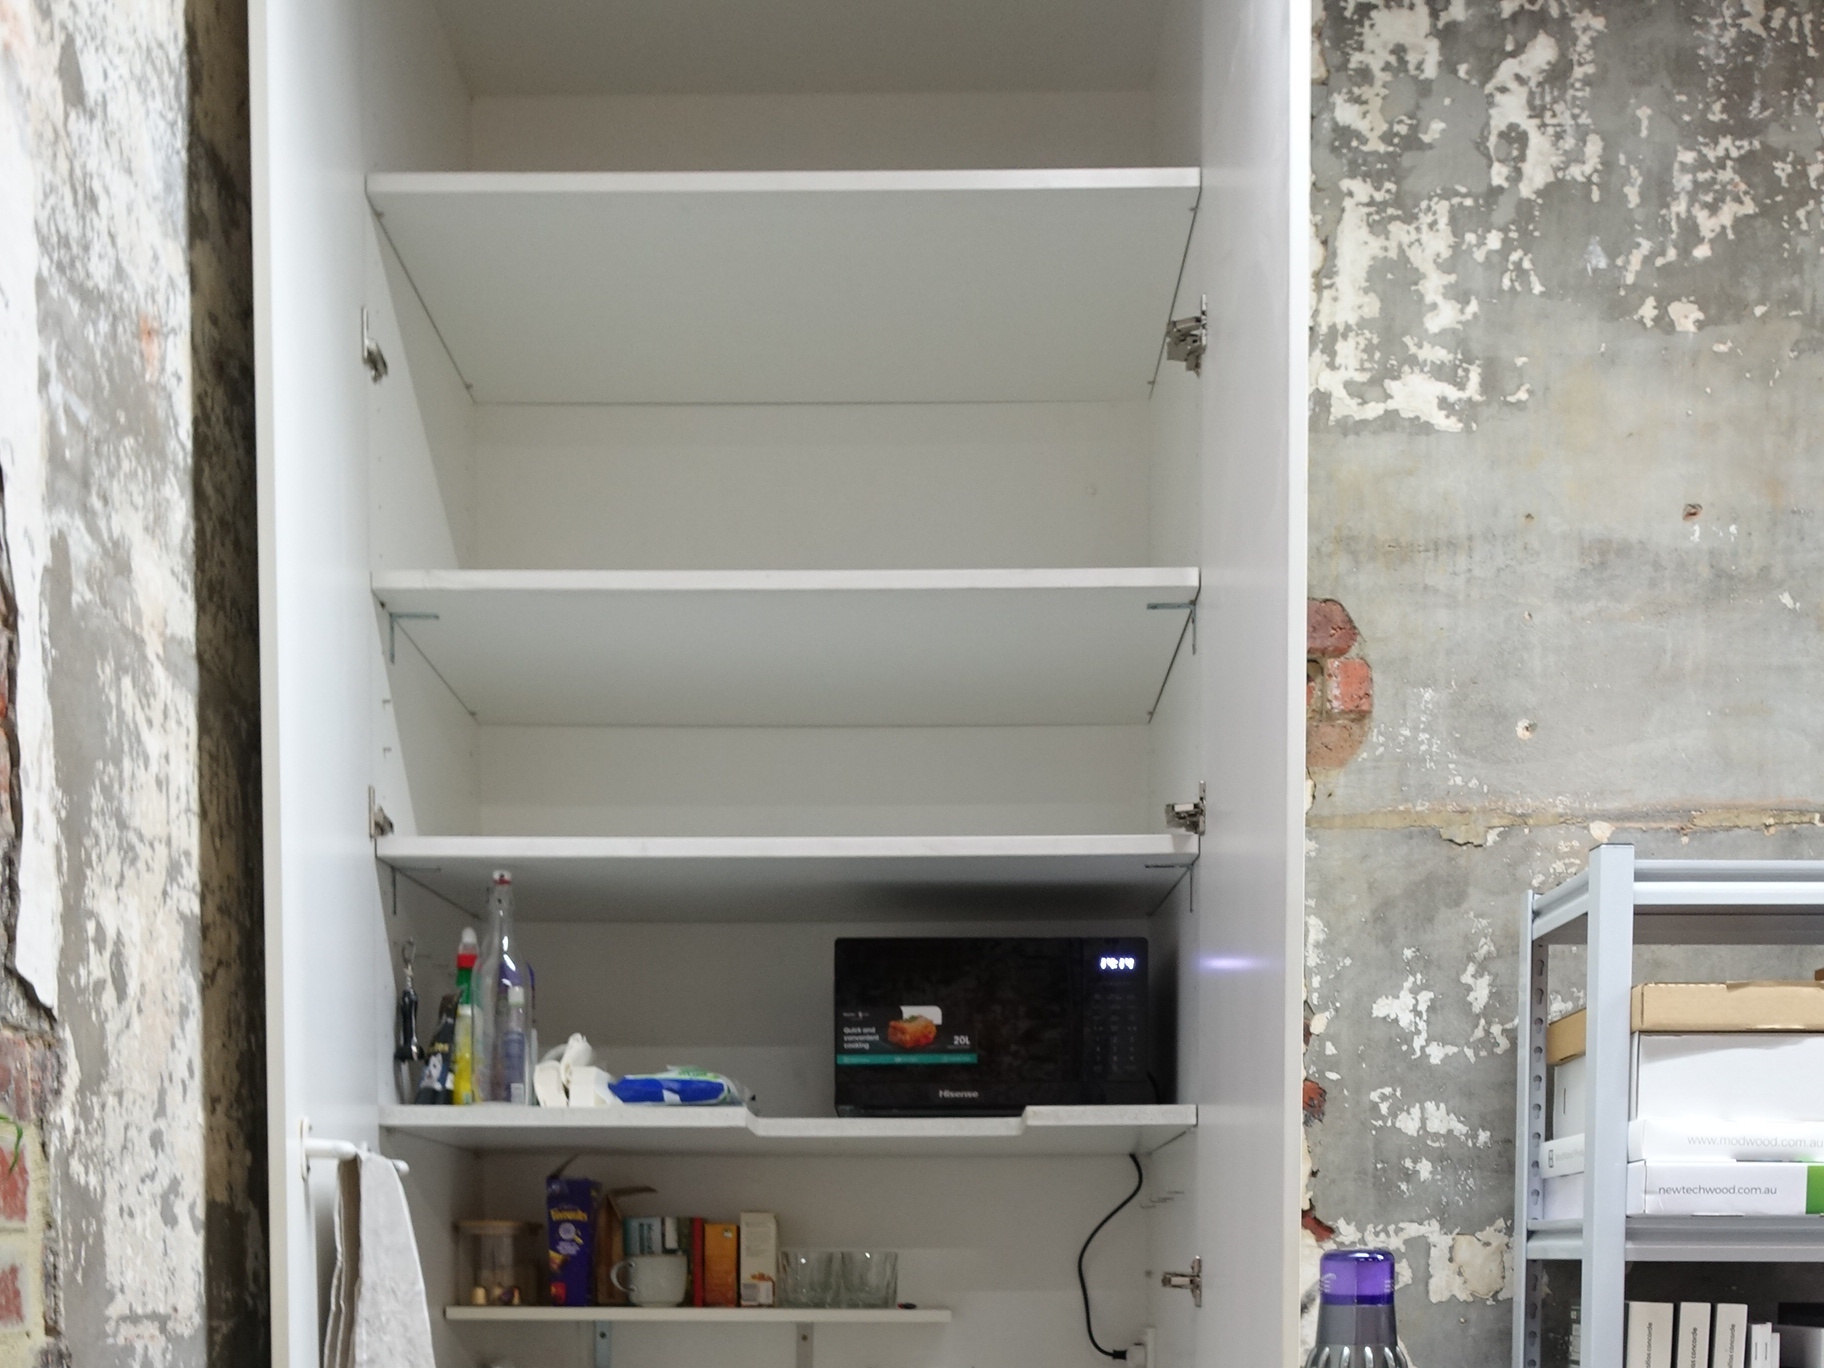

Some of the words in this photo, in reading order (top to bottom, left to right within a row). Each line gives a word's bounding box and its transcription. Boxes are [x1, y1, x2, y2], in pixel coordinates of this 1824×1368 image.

[939, 1090, 979, 1098] Hisense
[1687, 1136, 1823, 1147] www.modwood.com.au
[1658, 1185, 1777, 1195] newtechwood.com.au
